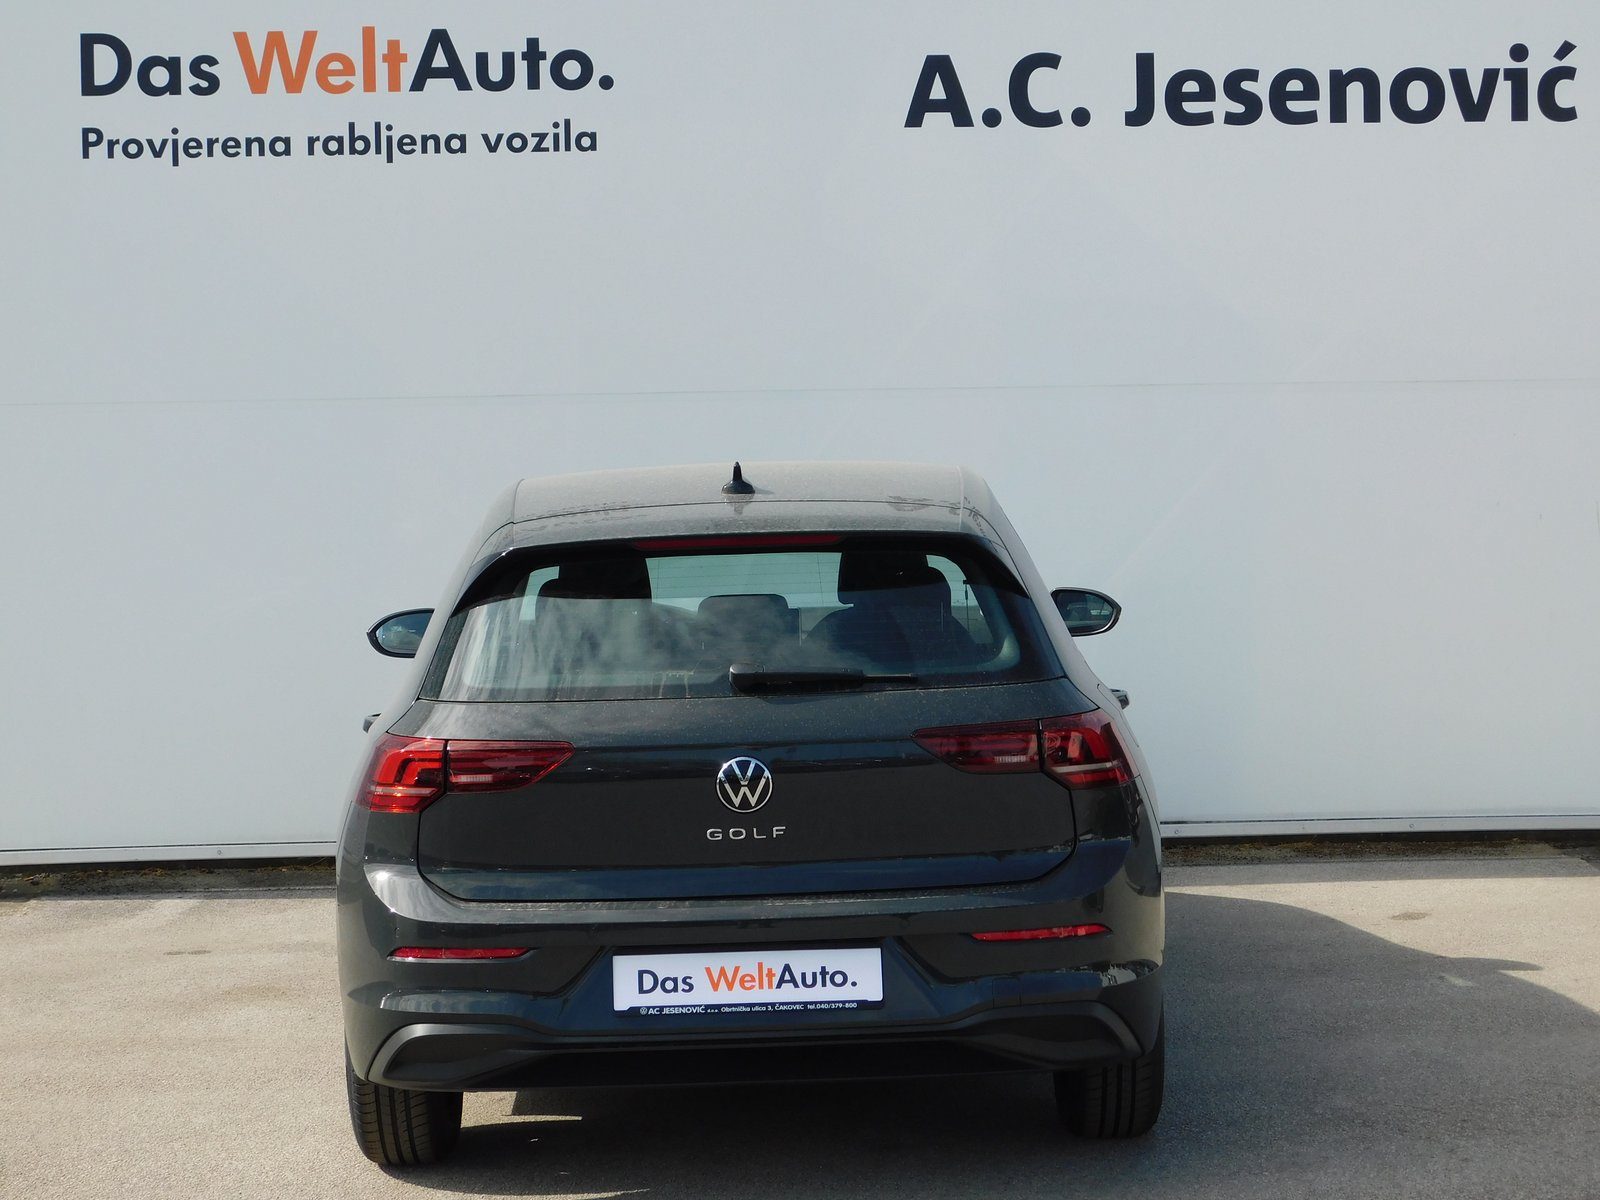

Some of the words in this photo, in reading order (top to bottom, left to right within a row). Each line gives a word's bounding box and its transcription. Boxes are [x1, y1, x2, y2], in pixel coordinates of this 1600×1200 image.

[79, 32, 221, 98] Das
[232, 26, 615, 95] WeltAuto.
[903, 51, 1092, 129] A.C.
[1124, 39, 1578, 128] Jesenović
[81, 127, 292, 167] Provjerena
[307, 121, 467, 164] rabljena
[480, 118, 598, 154] vozila
[706, 826, 786, 841] GOLF
[637, 969, 695, 995] Das
[705, 961, 858, 992] WeltAuto.
[648, 1007, 660, 1015] AC
[661, 1005, 706, 1014] JESENOVIĆ
[775, 1003, 805, 1011] ČAKOVEC
